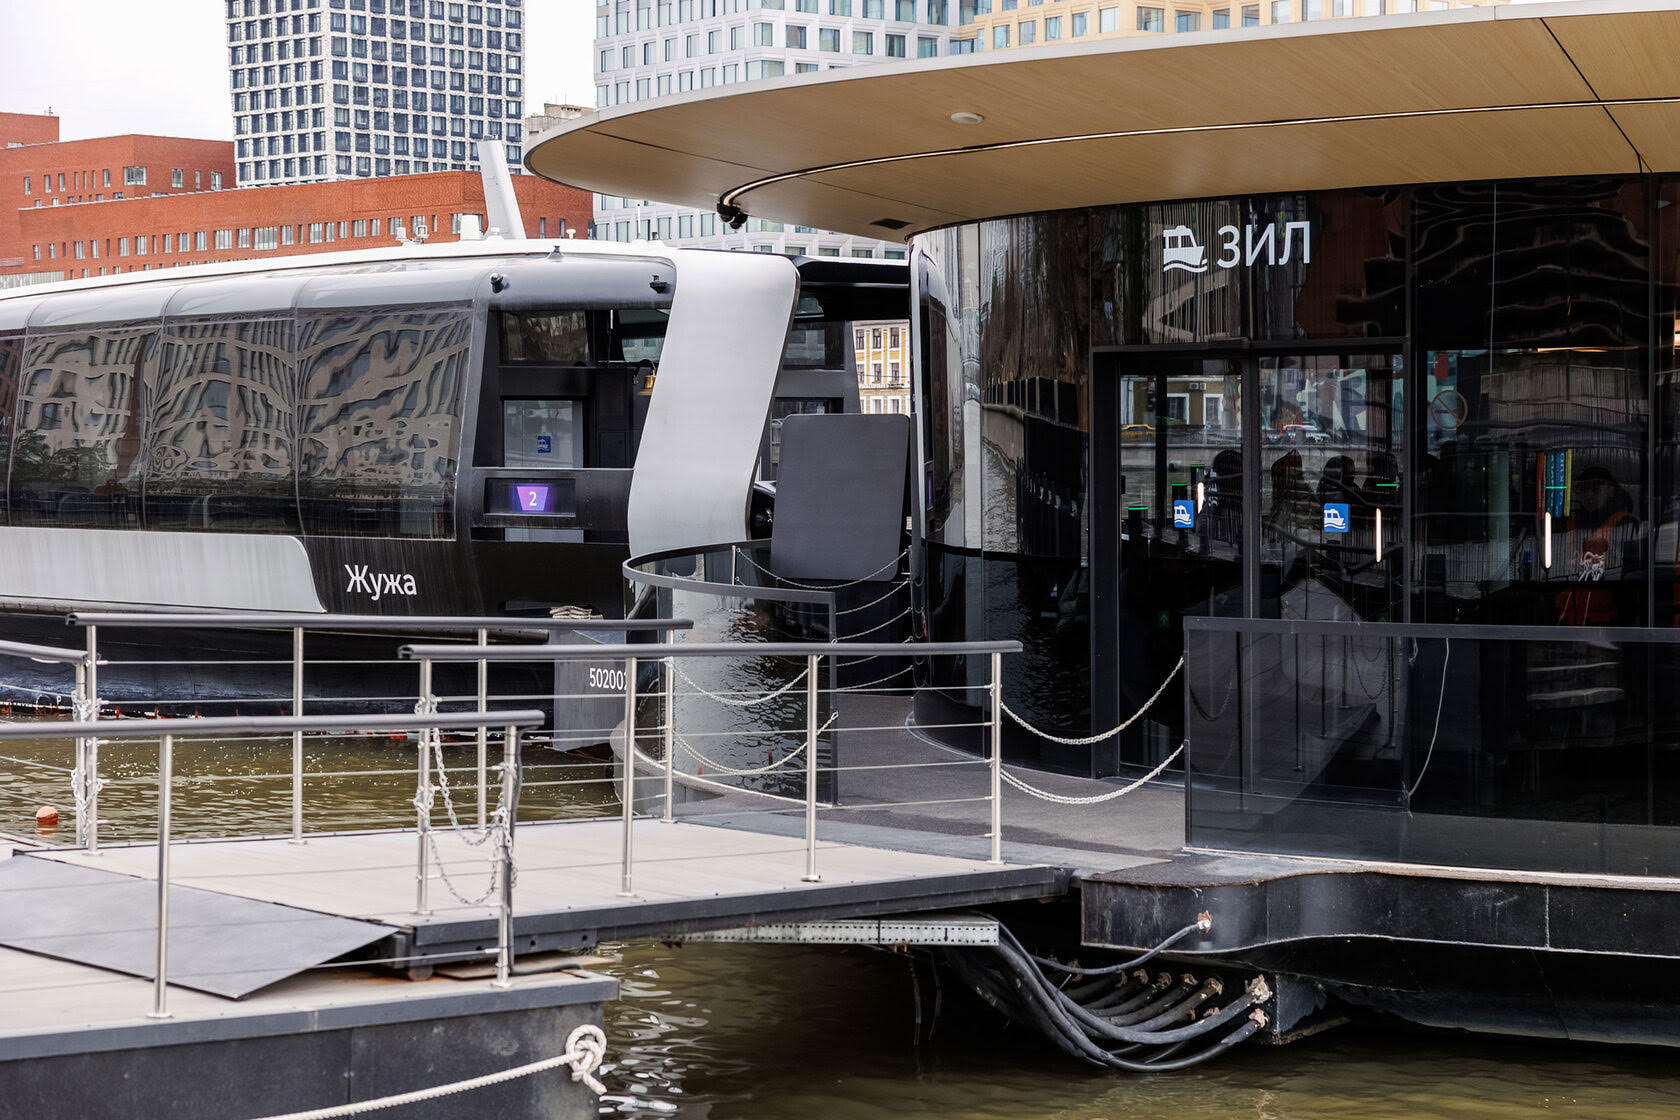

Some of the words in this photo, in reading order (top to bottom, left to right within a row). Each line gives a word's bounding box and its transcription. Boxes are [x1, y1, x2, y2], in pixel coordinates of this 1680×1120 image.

[1216, 221, 1310, 269] ЗИЛ
[529, 491, 537, 506] 2
[344, 564, 417, 601] Жужа
[589, 667, 627, 691] 50200
